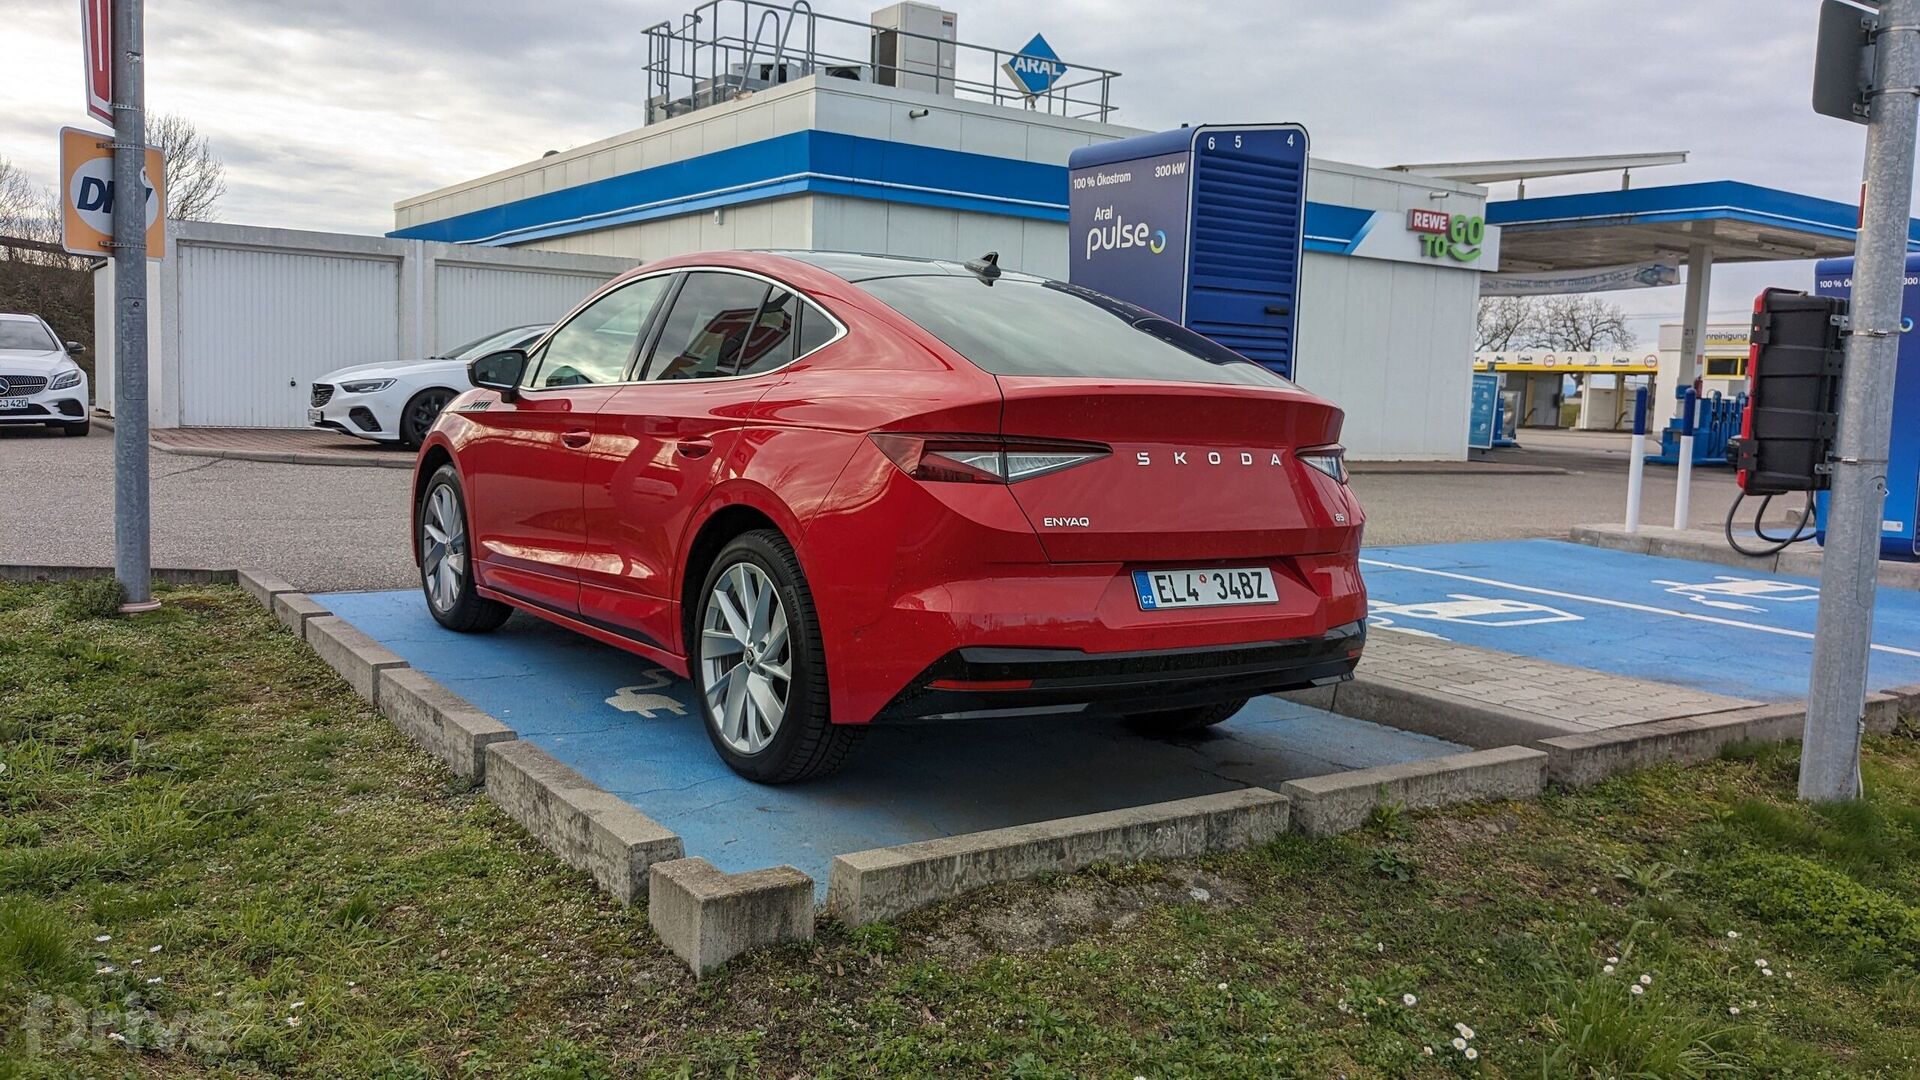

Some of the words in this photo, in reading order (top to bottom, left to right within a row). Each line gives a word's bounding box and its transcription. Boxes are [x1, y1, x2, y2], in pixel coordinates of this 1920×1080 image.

[1014, 57, 1061, 75] ARAL
[1207, 137, 1215, 150] 6
[1234, 135, 1242, 148] 5
[1286, 134, 1294, 147] 4
[1154, 164, 1171, 178] 300
[1171, 161, 1186, 175] kW
[1073, 177, 1086, 189] 100
[1087, 176, 1095, 187] %
[1096, 172, 1131, 186] Ökostrom
[1094, 205, 1113, 221] Aral
[1413, 212, 1447, 230] REWE
[1086, 215, 1150, 260] pulse
[1421, 233, 1448, 257] TO
[1450, 214, 1485, 245] GO
[1819, 280, 1832, 288] 100
[1043, 517, 1090, 528] ENYAQ
[1335, 512, 1345, 522] 85
[1154, 574, 1199, 603] EL4
[1212, 572, 1268, 600] 34BZ
[1141, 595, 1154, 604] CZ
